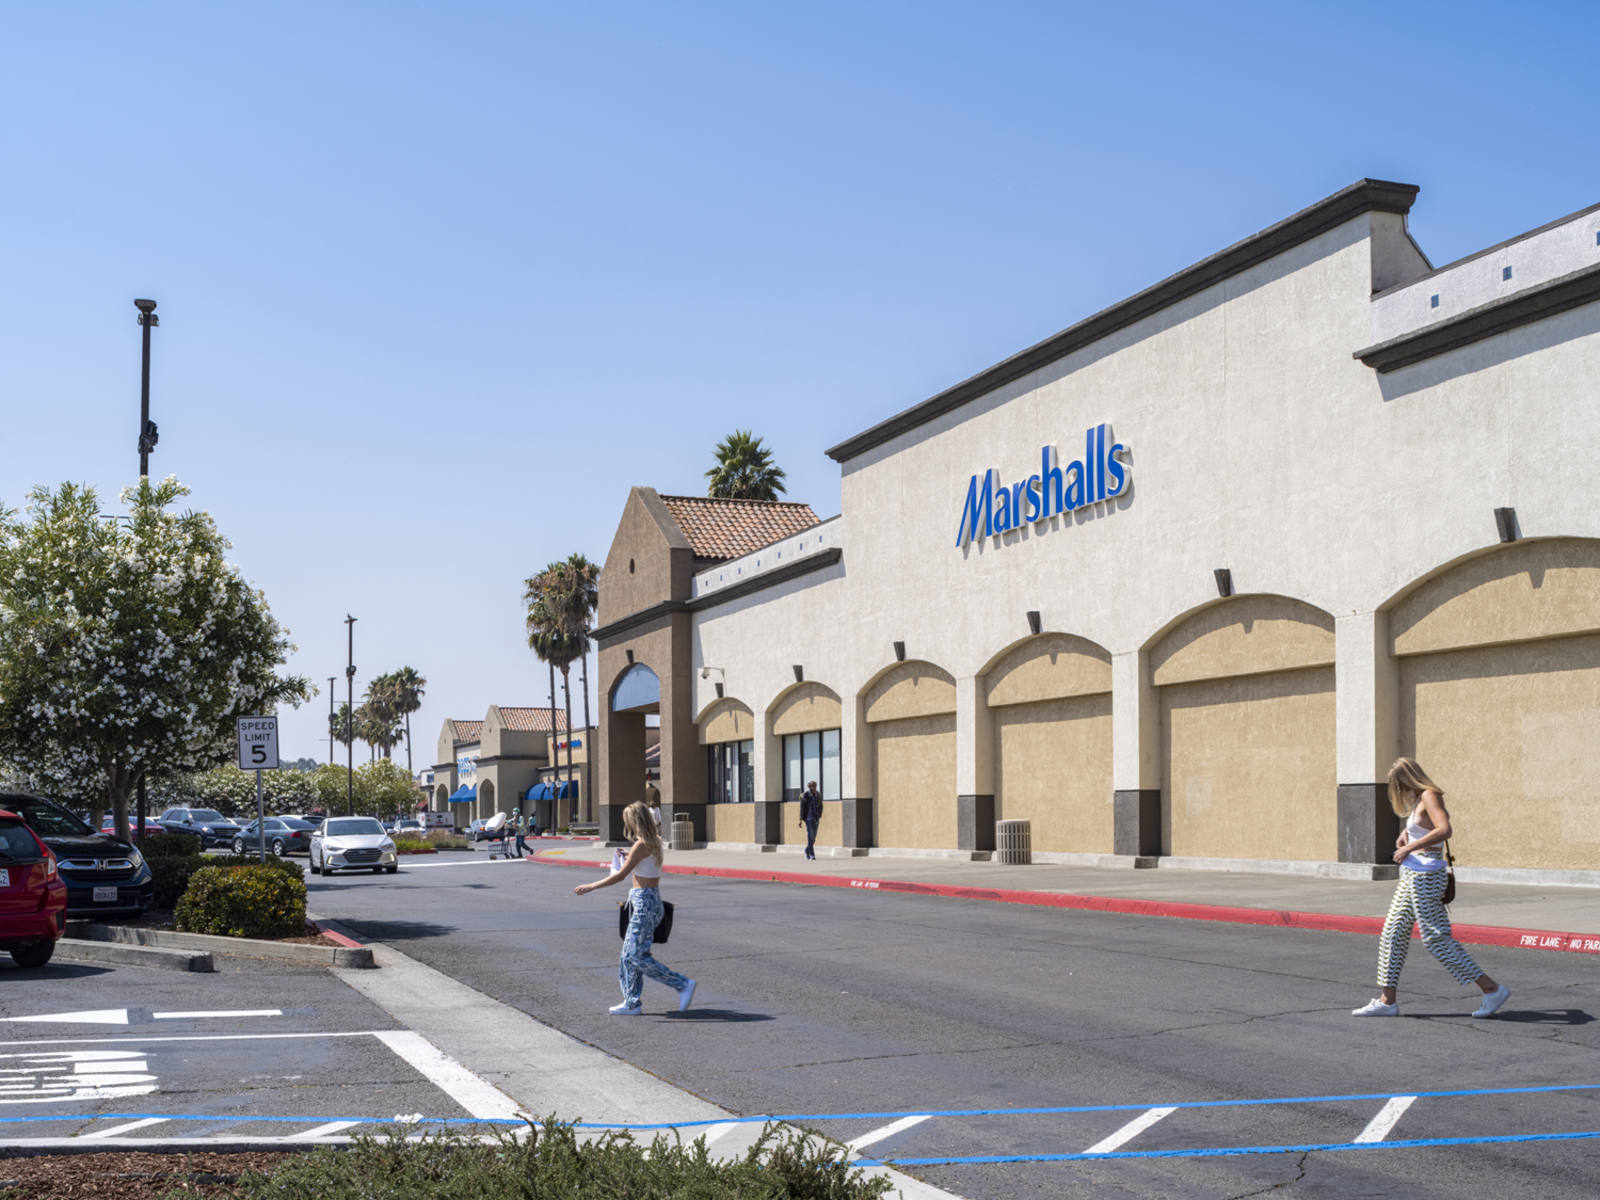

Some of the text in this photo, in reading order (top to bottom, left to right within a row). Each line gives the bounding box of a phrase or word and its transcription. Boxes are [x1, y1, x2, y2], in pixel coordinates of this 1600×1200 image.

[955, 423, 1131, 547] Marshalls
[241, 721, 275, 731] SPEED
[244, 733, 272, 742] LIMIT
[252, 744, 267, 764] 5
[1520, 935, 1539, 946] FIRE
[1539, 936, 1562, 948] LANE
[1569, 938, 1582, 949] NO
[1583, 940, 1600, 950] PAR
